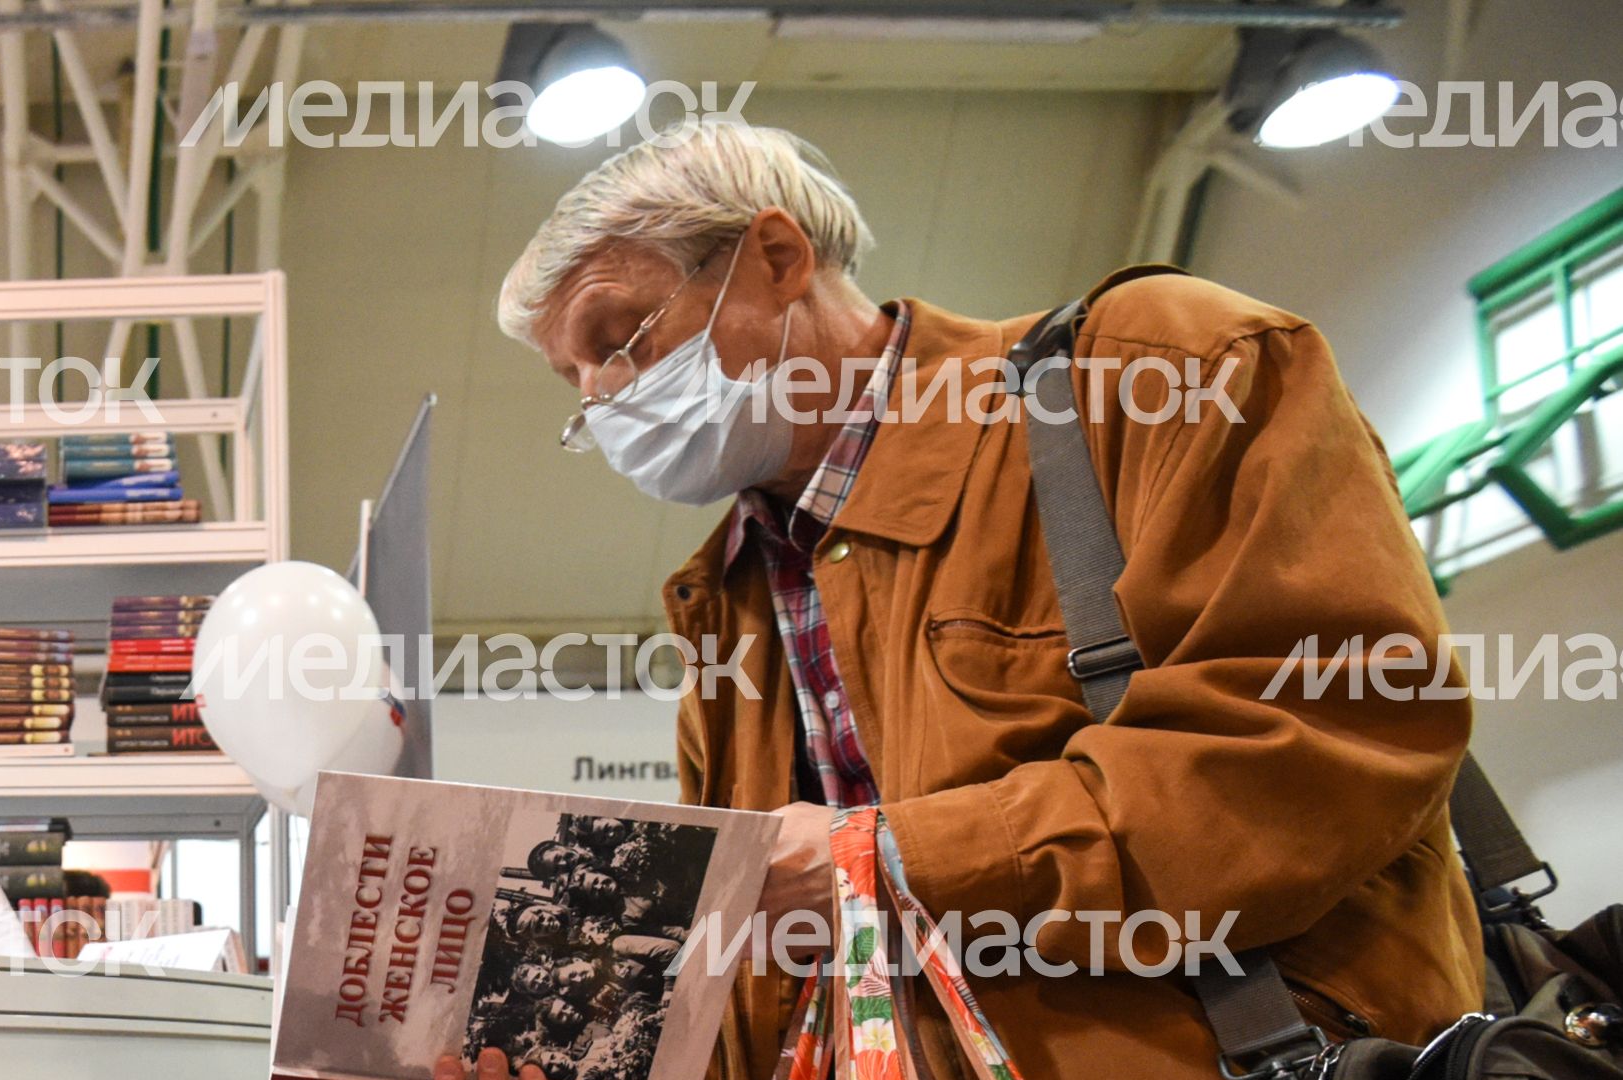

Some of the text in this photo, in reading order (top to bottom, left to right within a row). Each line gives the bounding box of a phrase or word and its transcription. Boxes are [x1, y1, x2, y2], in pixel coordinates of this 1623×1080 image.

[572, 756, 680, 783] Лингв
[334, 833, 395, 1028] ДОБЛЕСТИ
[377, 845, 437, 1025] ЖЕНСКОЕ
[429, 887, 476, 995] ЛИЦО
